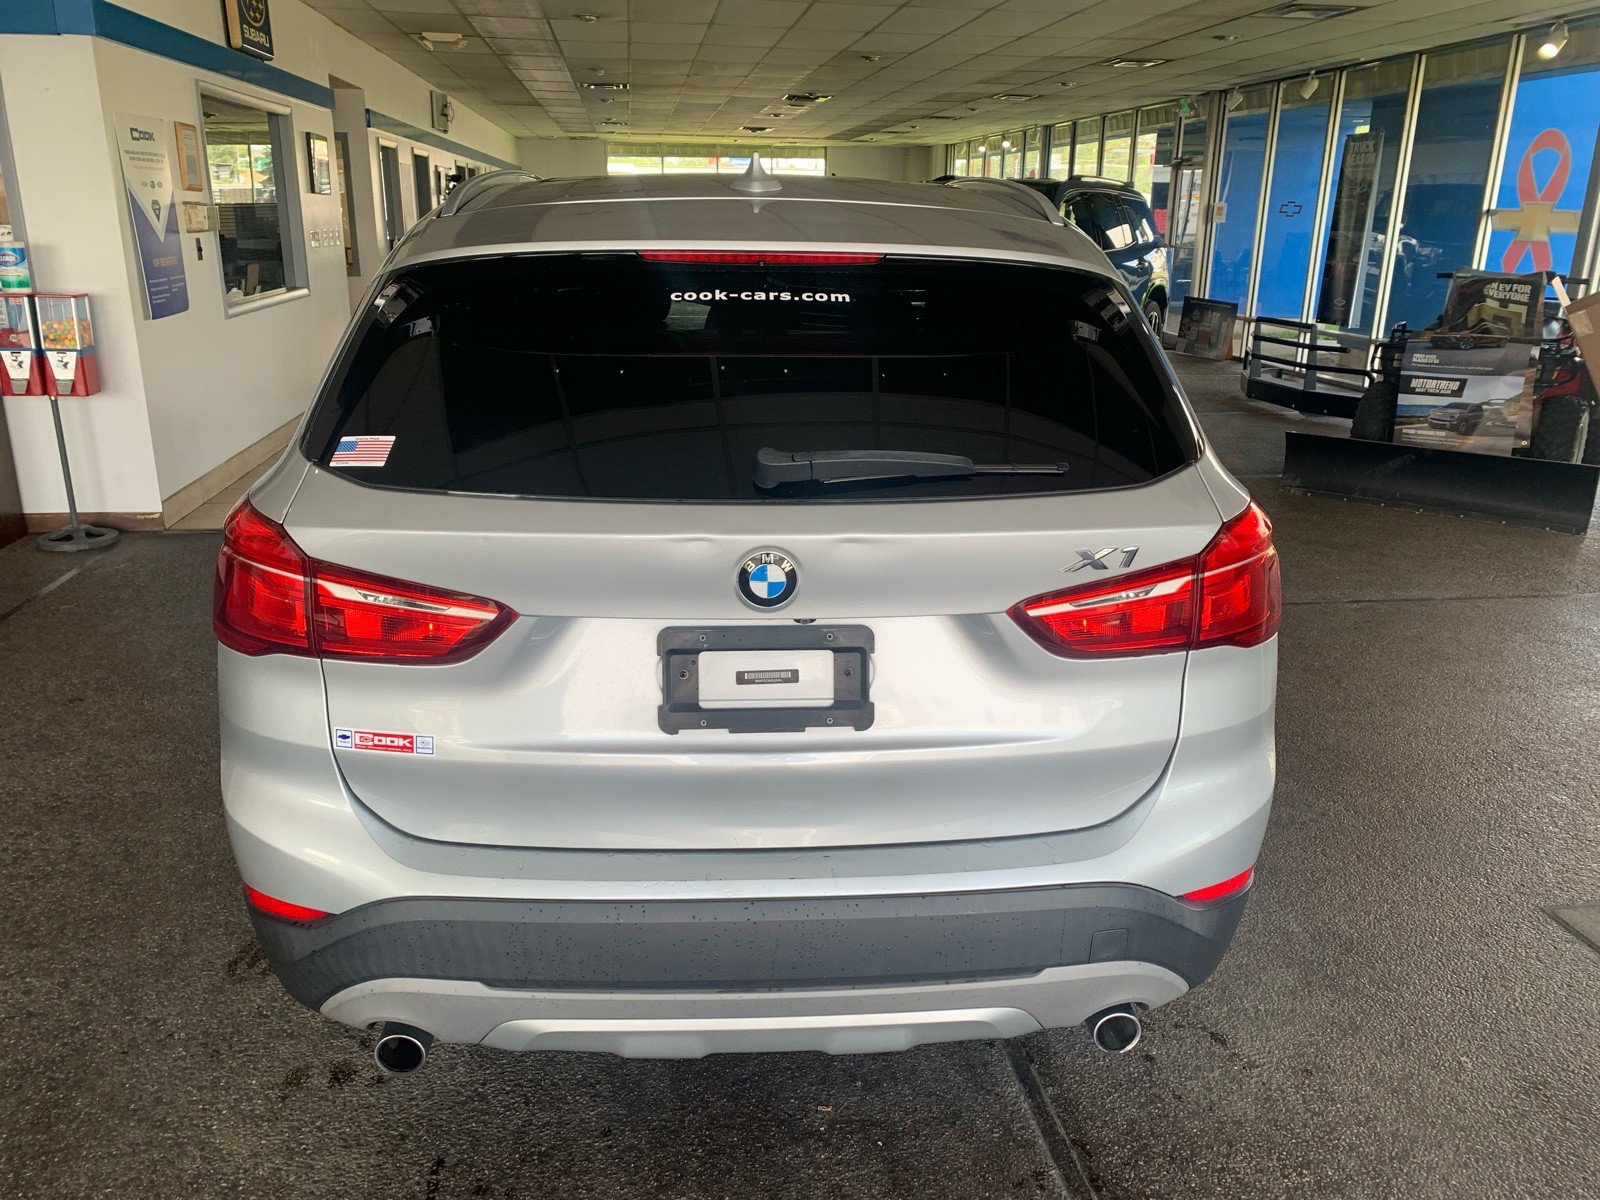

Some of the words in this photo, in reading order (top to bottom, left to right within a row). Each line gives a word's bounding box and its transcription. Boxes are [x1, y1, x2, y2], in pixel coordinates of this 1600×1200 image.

[243, 24, 270, 47] SUBARU
[1350, 140, 1376, 153] TRUCK
[1346, 152, 1376, 166] SEASON
[670, 289, 851, 302] cook-cars.com
[1484, 288, 1530, 302] EVERYONE
[1501, 283, 1514, 292] EV
[1513, 284, 1532, 294] FOR
[1410, 378, 1460, 390] MOTORTREND
[745, 553, 794, 573] BMW
[1060, 546, 1140, 572] X1
[355, 733, 413, 747] COOK
